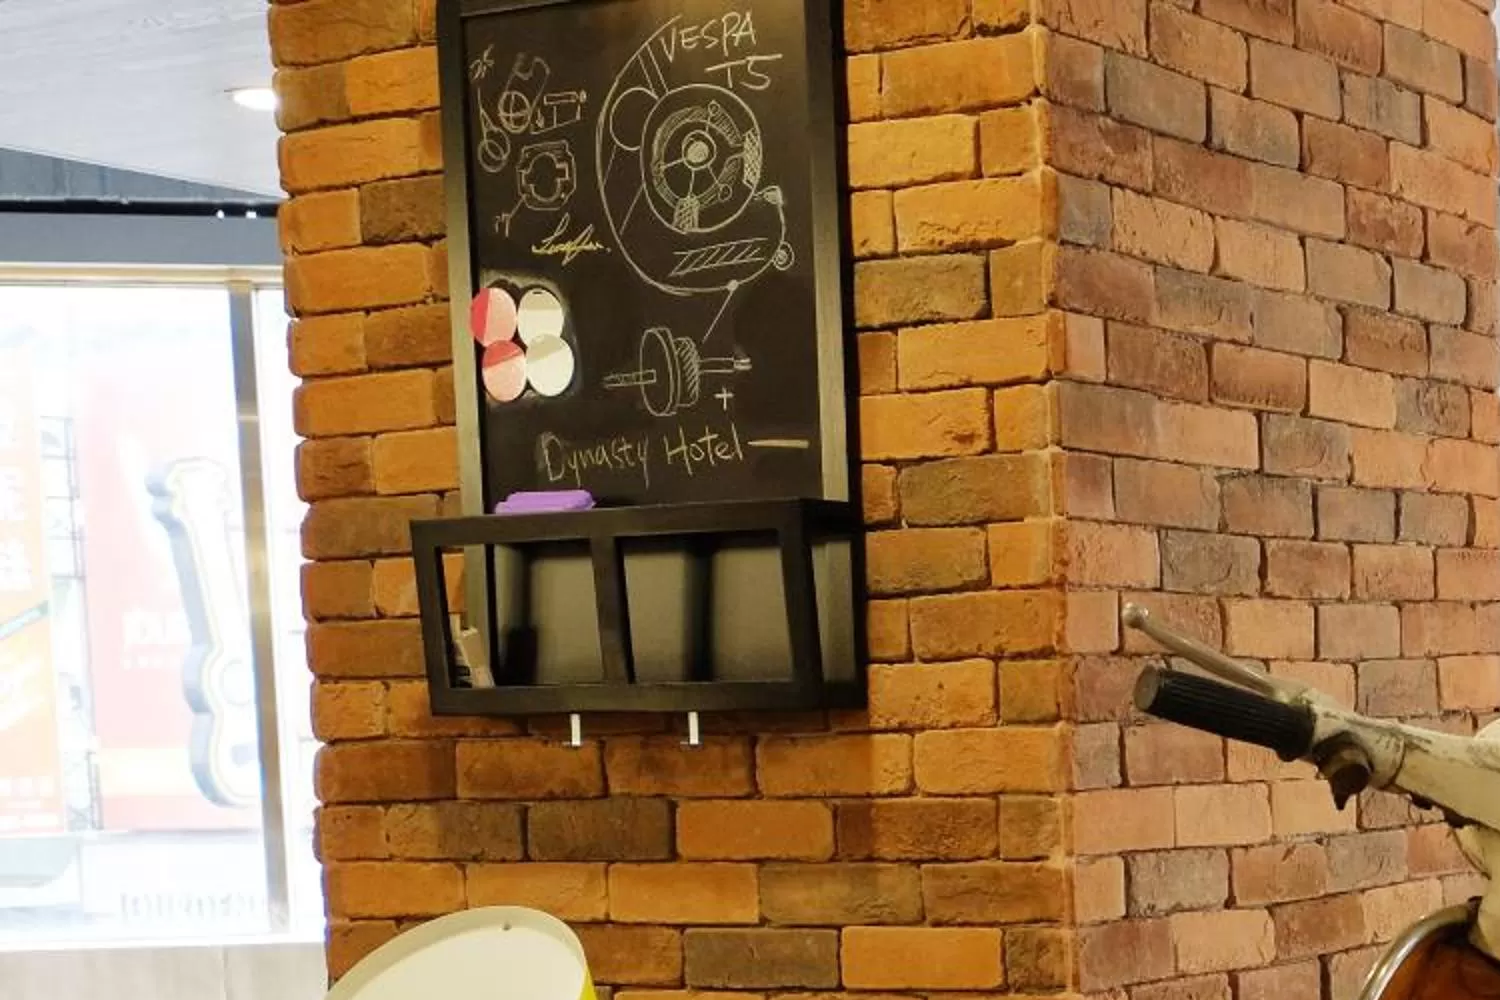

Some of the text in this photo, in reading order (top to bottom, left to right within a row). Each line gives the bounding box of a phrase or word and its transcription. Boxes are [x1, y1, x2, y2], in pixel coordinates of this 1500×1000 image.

[659, 9, 757, 63] VESPA
[537, 423, 743, 490] Dynasty Hotel
